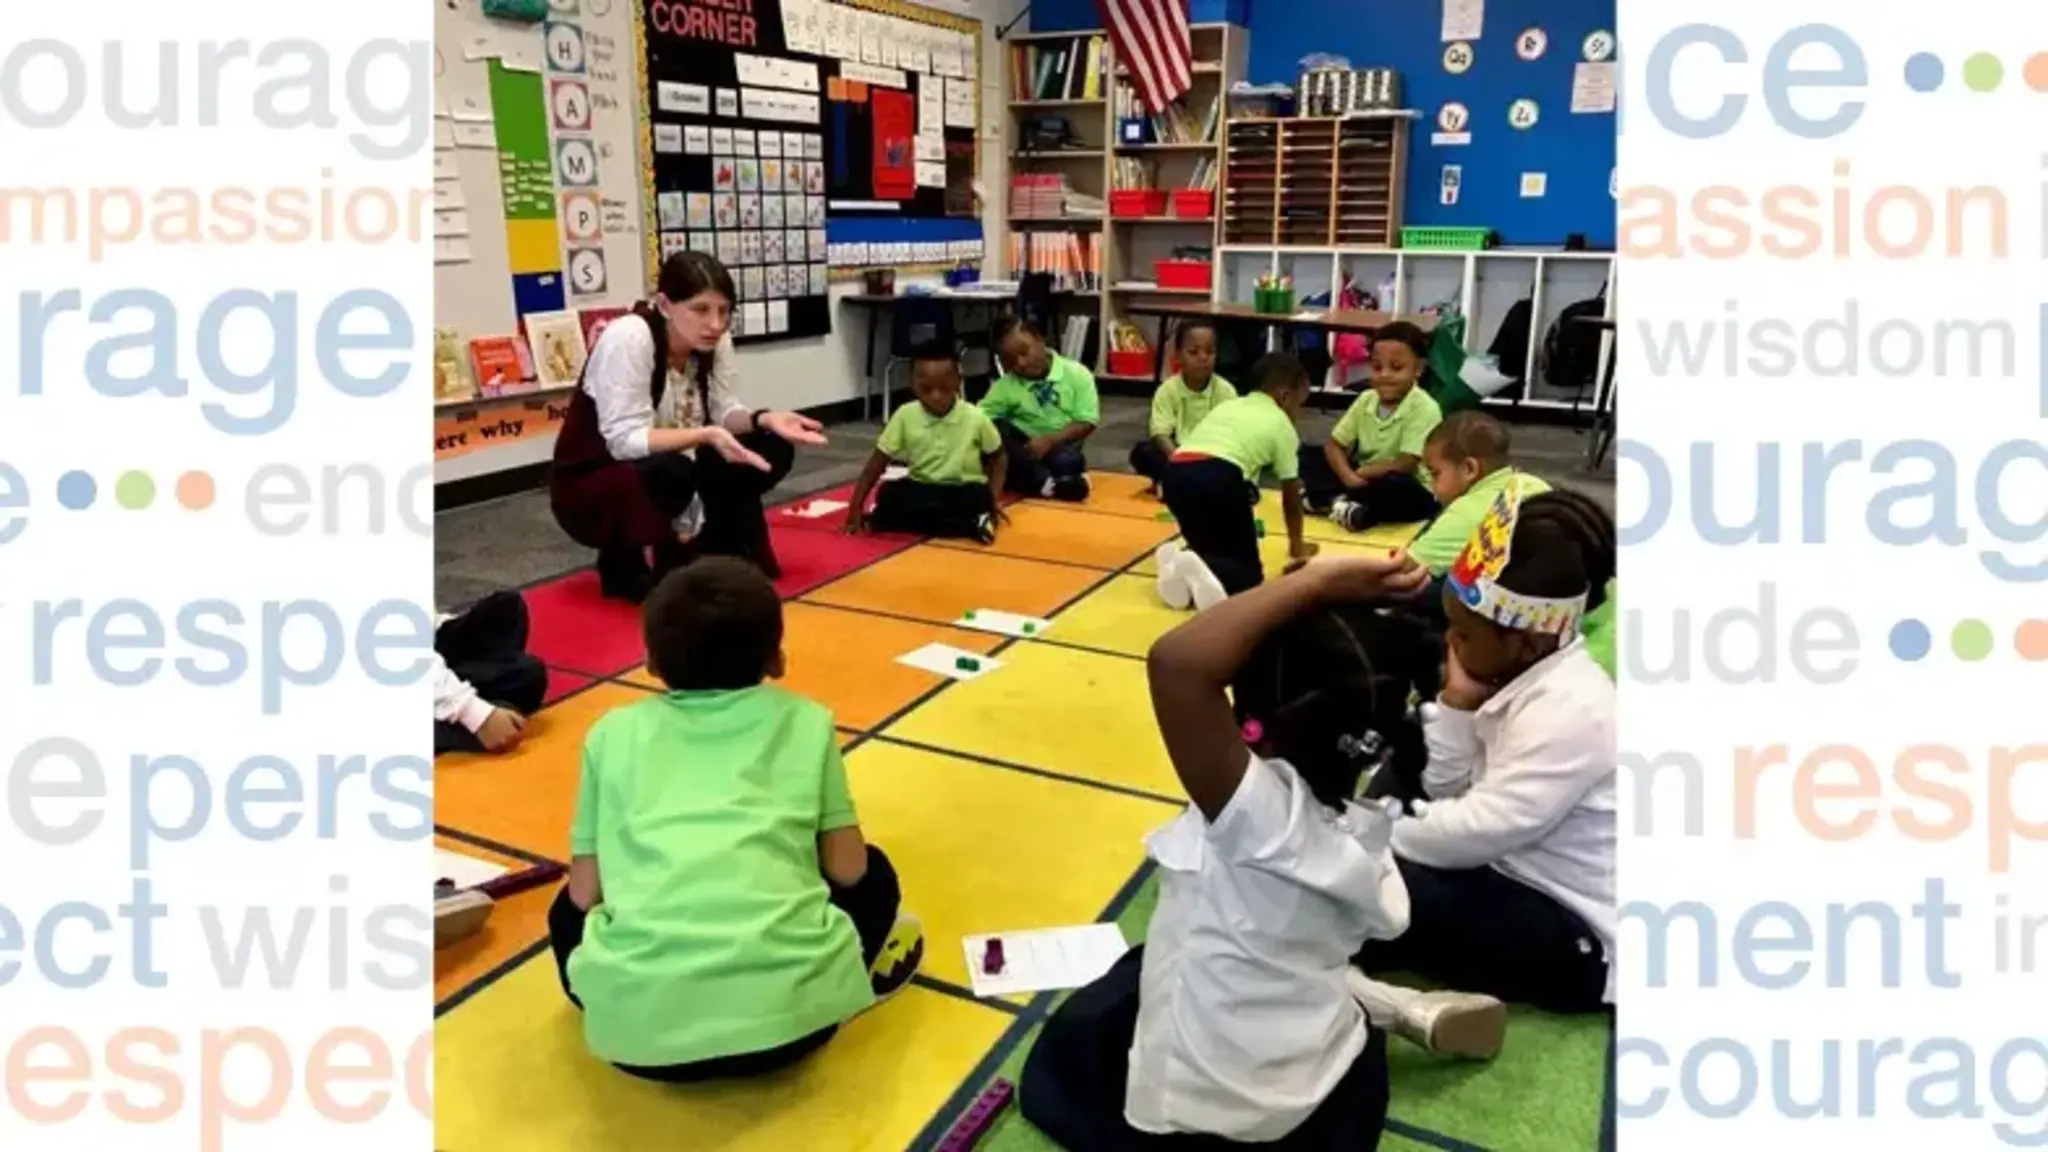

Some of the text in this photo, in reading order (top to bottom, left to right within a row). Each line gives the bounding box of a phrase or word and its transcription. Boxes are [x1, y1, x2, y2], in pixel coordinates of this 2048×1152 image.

[651, 1, 757, 47] CORNER
[558, 41, 571, 60] H
[566, 98, 579, 119] A
[568, 156, 586, 175] M
[578, 210, 589, 230] P
[581, 264, 594, 285] S
[434, 432, 468, 451] ere
[480, 419, 524, 440] why
